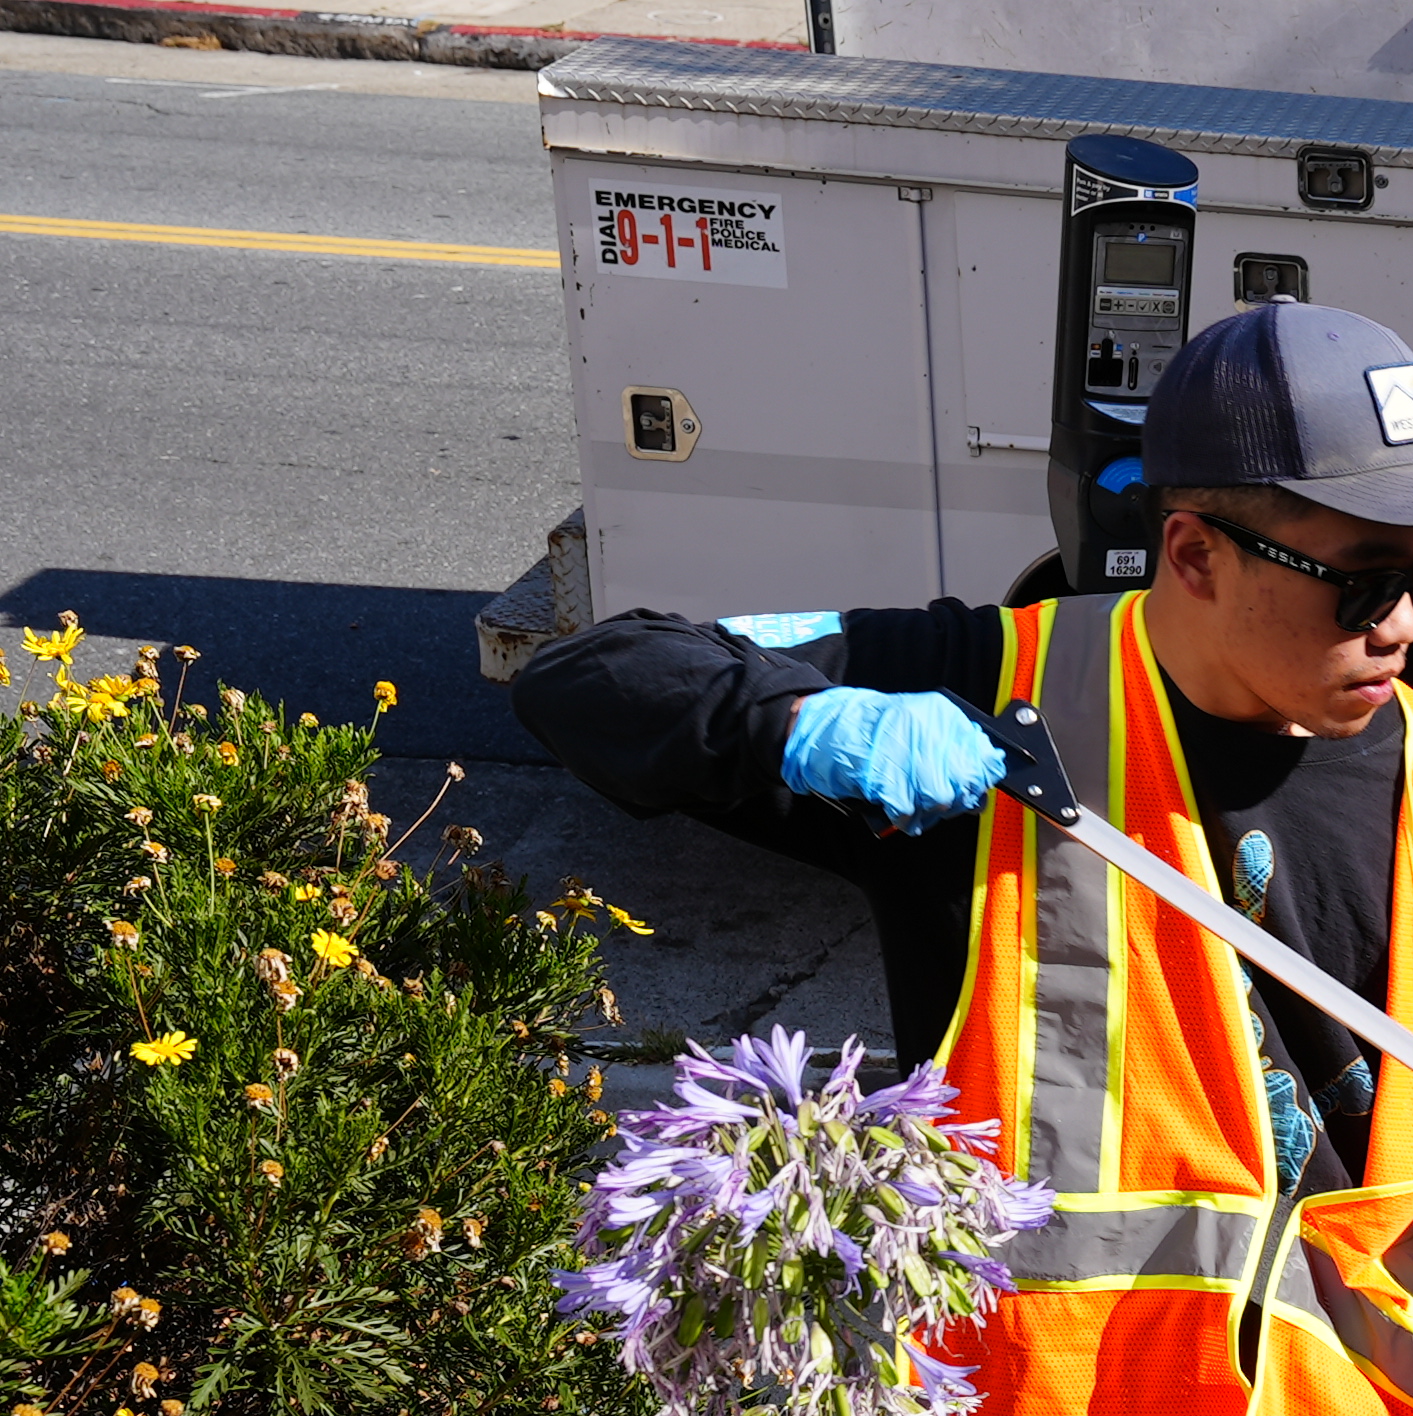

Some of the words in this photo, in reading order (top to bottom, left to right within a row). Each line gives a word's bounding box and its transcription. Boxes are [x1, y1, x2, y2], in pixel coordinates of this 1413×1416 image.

[595, 190, 776, 220] EMERGENCY
[709, 217, 745, 230] FIRE
[598, 209, 619, 265] DIAL
[617, 209, 712, 272] 9-1-1
[710, 228, 766, 241] POLICE
[711, 238, 781, 252] MEDICAL
[1116, 555, 1135, 565] 691
[1256, 541, 1312, 573] TESLA
[1110, 565, 1142, 575] 16290
